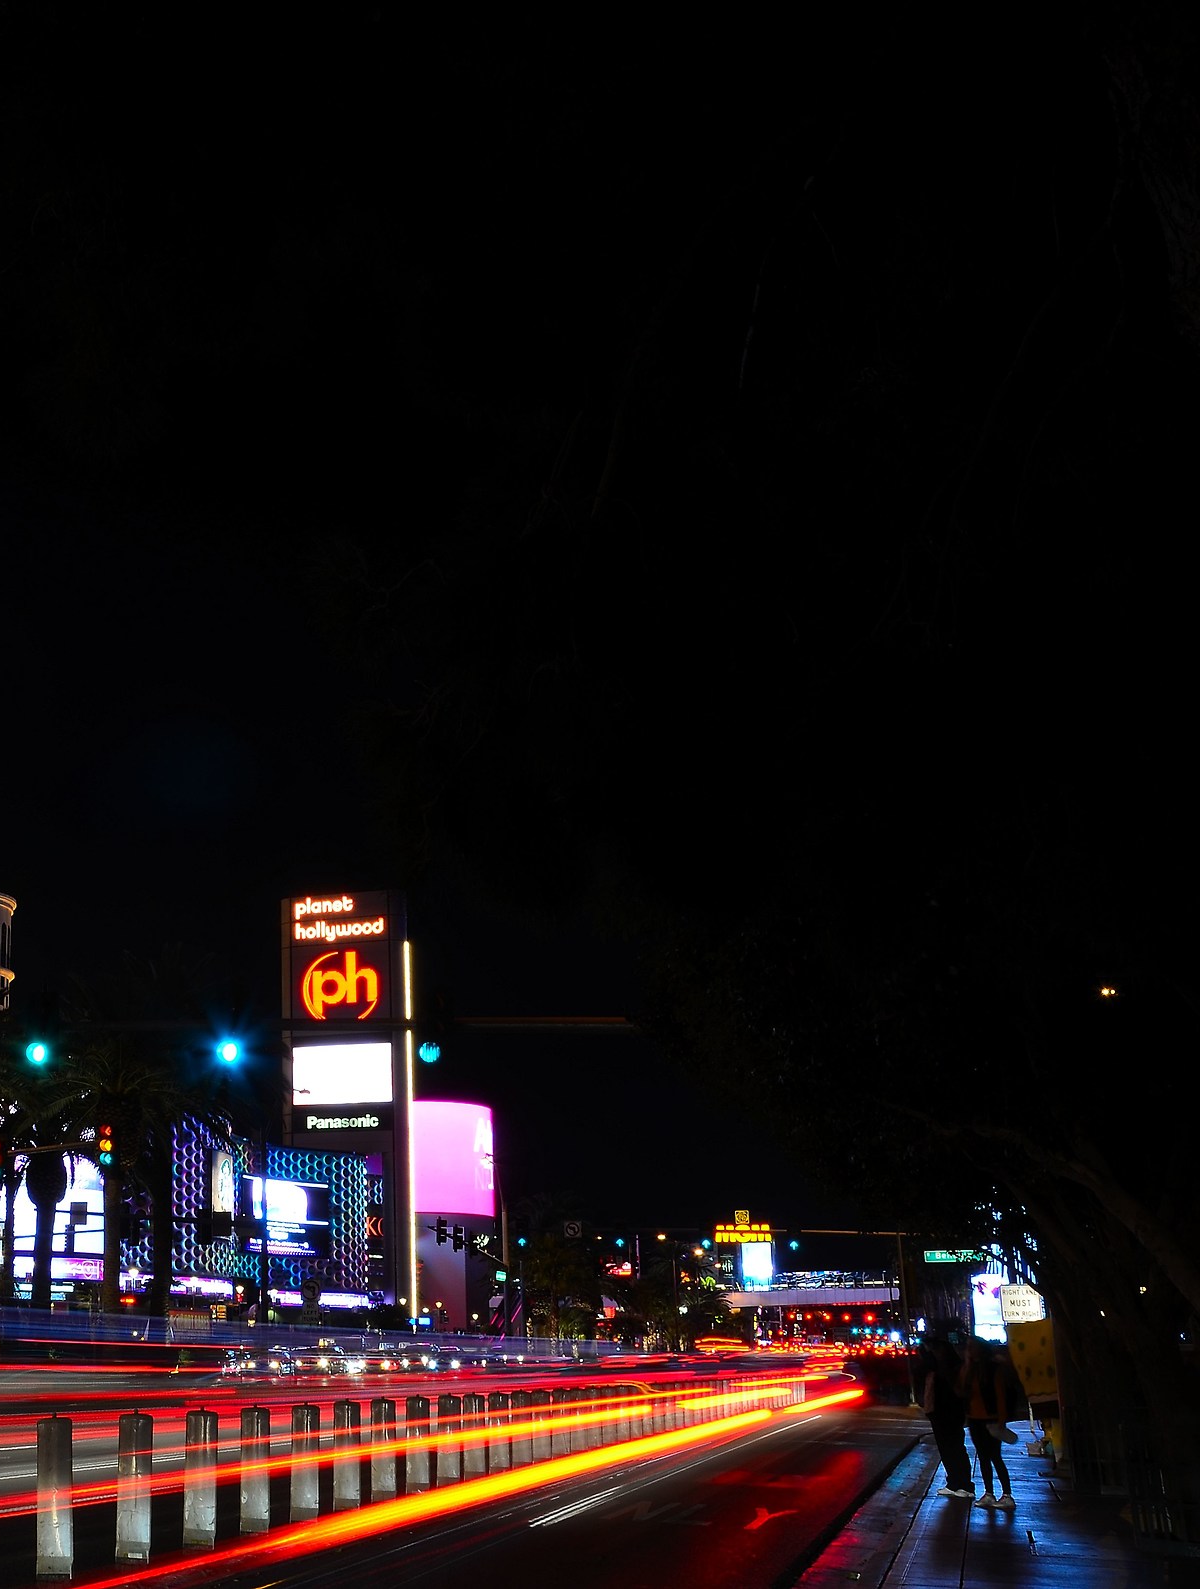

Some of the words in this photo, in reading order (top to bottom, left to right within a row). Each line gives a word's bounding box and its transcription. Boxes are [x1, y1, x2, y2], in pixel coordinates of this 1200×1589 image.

[294, 896, 354, 920] planet
[294, 917, 385, 941] hollywood
[311, 951, 378, 1016] ph
[306, 1114, 380, 1130] Panasonic
[715, 1223, 772, 1243] MGM
[1002, 1288, 1020, 1297] RIGHT
[1021, 1288, 1038, 1297] LANE
[1009, 1299, 1031, 1307] MUST
[1004, 1310, 1020, 1318] TURN
[1021, 1310, 1040, 1318] RIGHT
